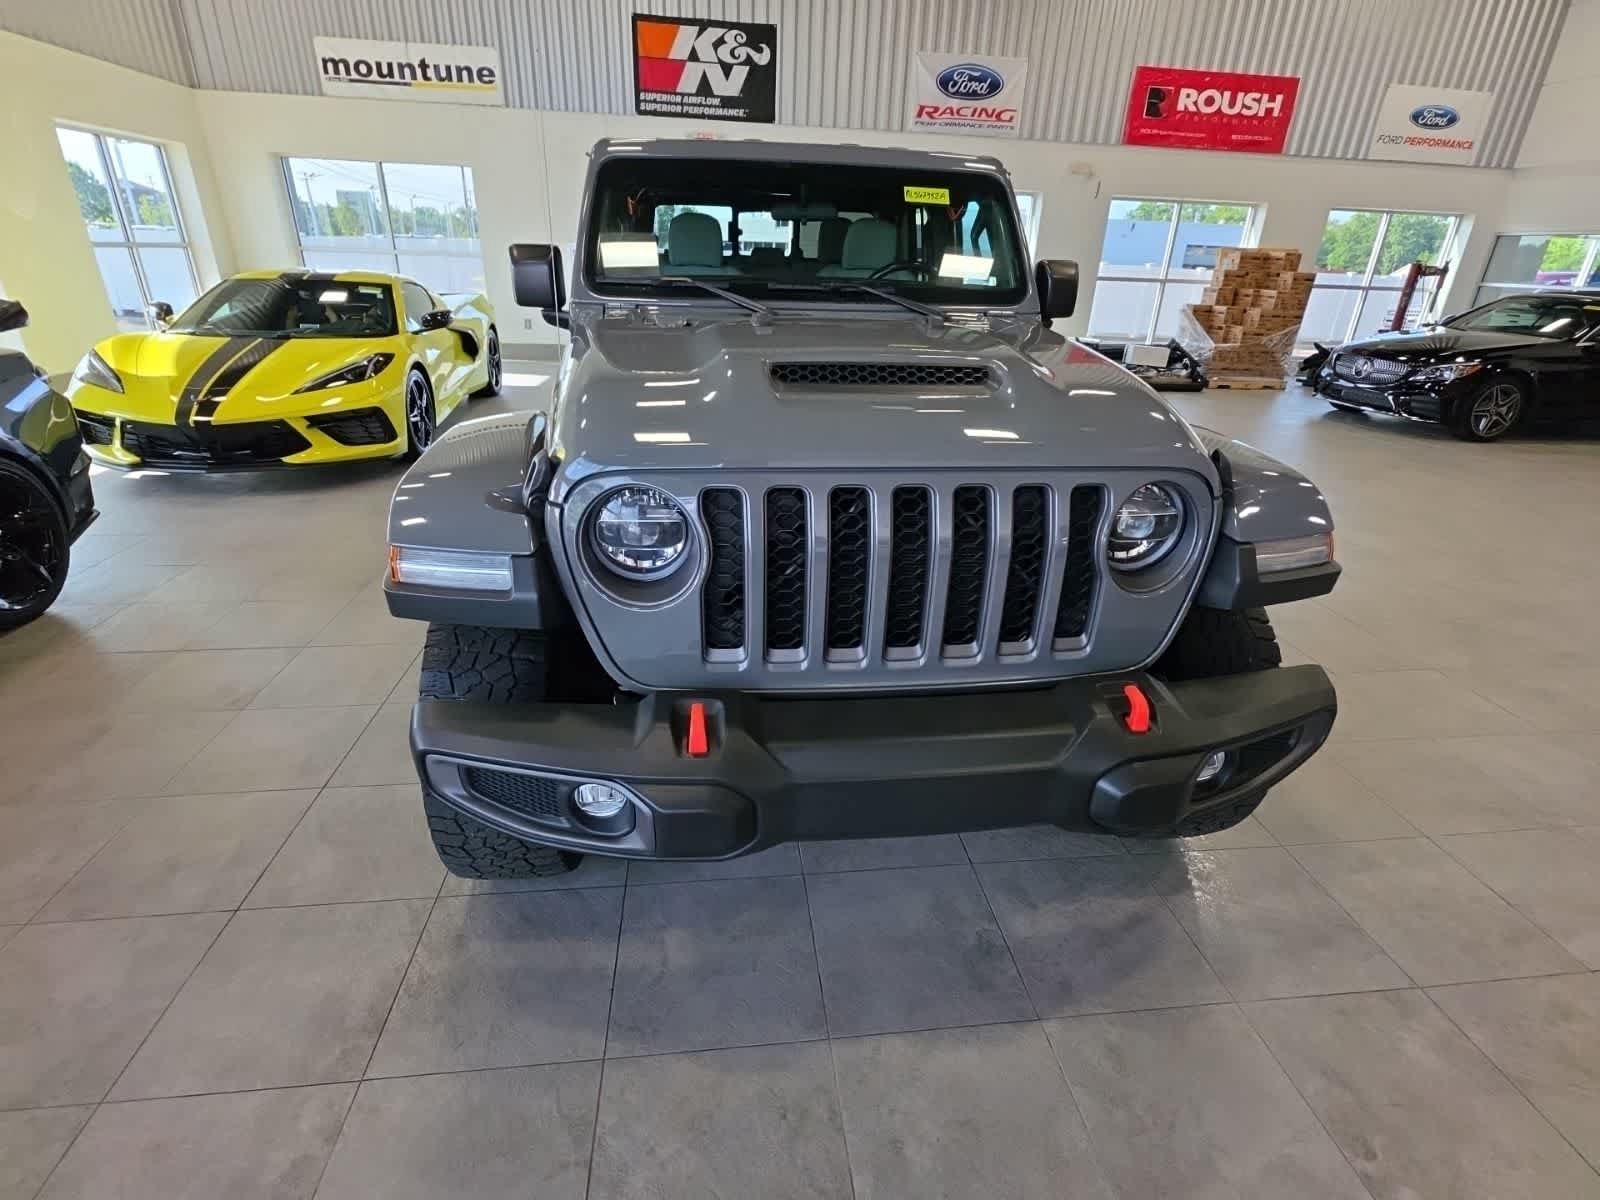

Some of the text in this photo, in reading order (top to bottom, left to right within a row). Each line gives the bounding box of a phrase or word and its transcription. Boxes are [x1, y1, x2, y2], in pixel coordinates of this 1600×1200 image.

[321, 56, 496, 85] mountune
[948, 69, 991, 94] Ford
[640, 92, 722, 106] SUPERIOR AIRFLOW.
[640, 103, 682, 113] SUPERIOR
[1176, 87, 1284, 117] ROUSH
[916, 104, 1017, 123] RACING
[1418, 108, 1451, 126] Ford
[1377, 134, 1475, 150] FORD PERFORMANCE
